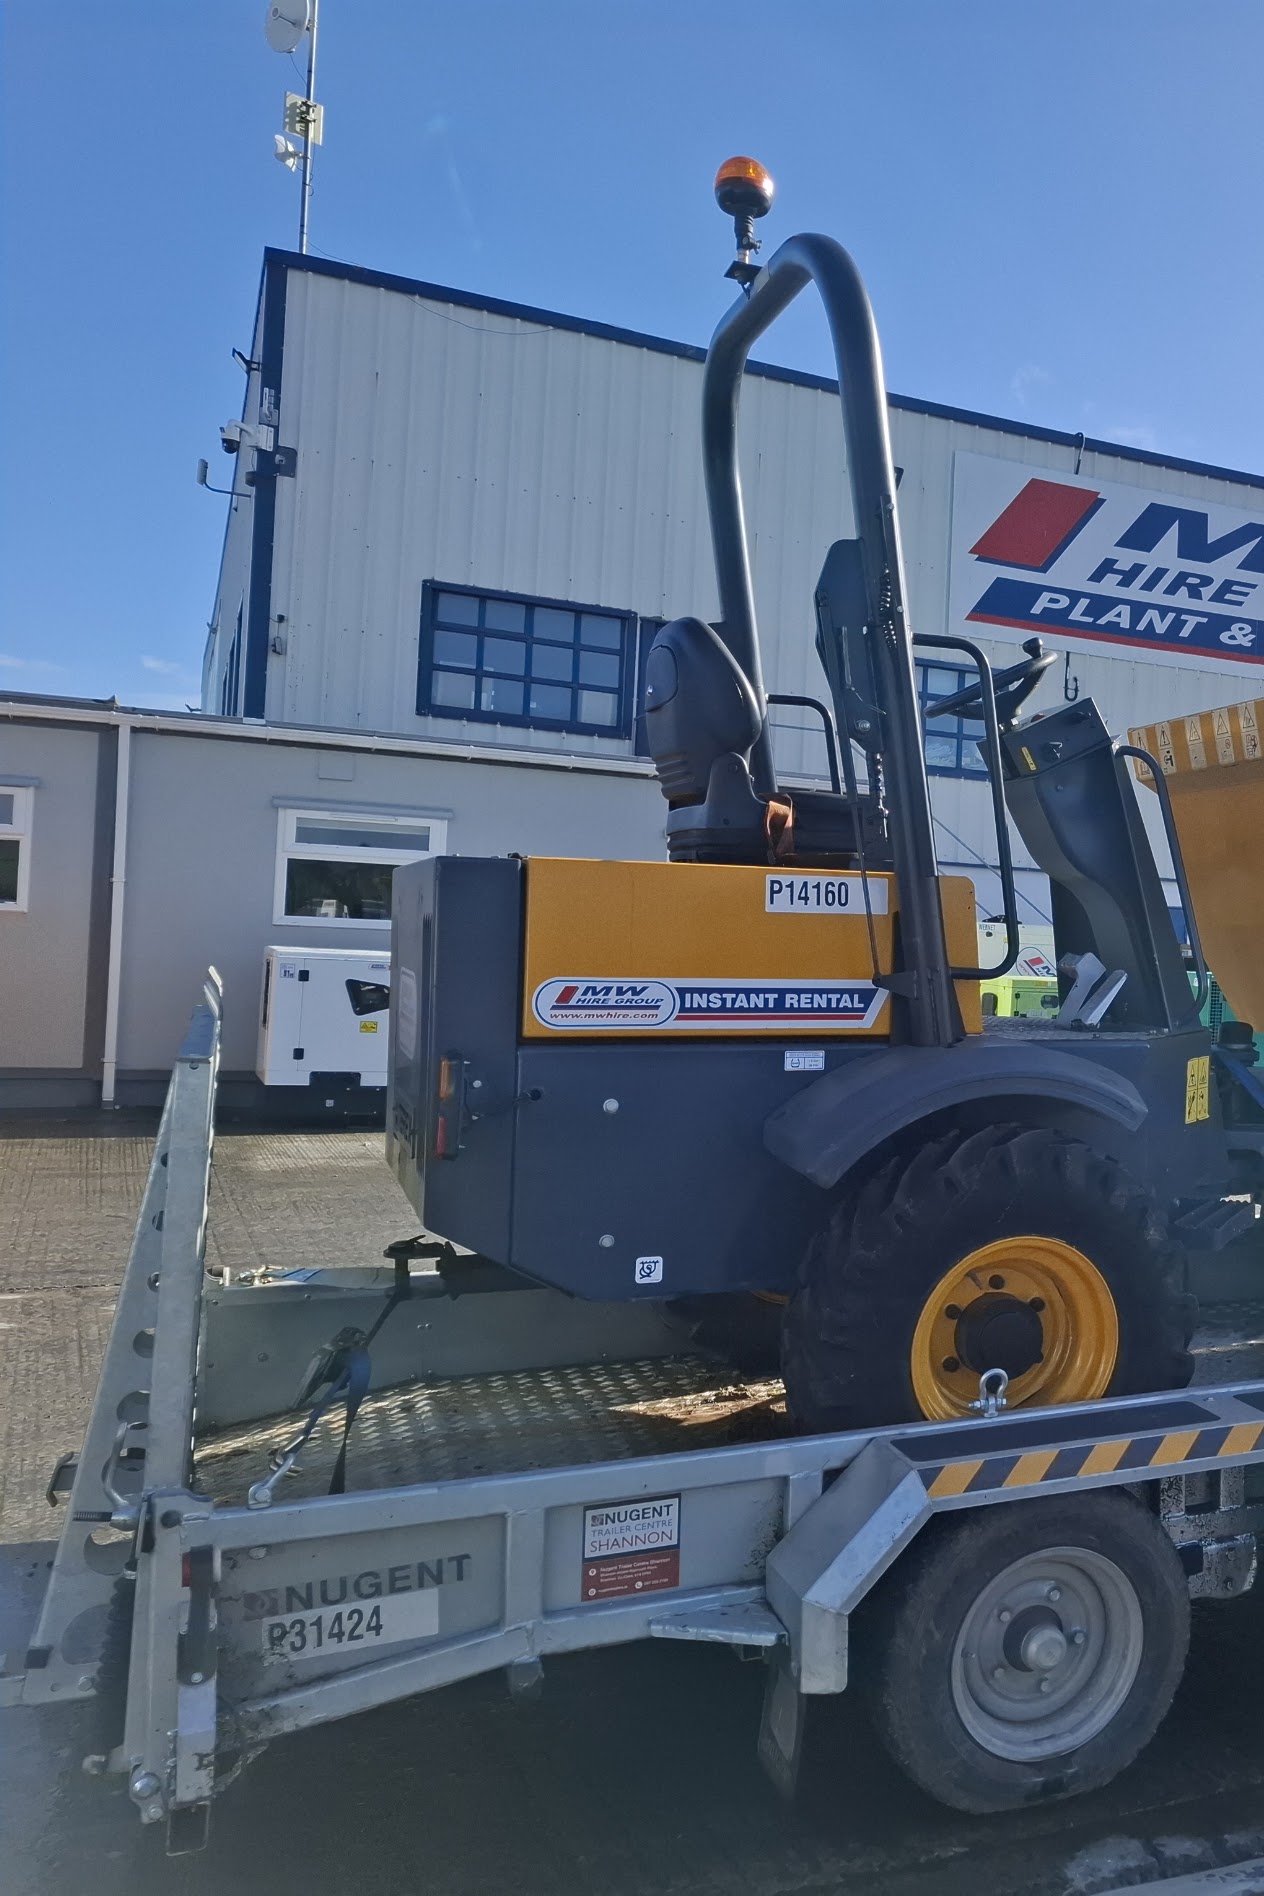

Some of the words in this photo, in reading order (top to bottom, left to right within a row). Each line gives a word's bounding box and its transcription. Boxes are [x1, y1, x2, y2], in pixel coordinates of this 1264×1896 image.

[1087, 557, 1257, 607] HIRE
[1029, 591, 1208, 640] PLANT
[1219, 622, 1254, 647] &
[769, 879, 850, 907] P14160
[580, 986, 650, 997] MW
[684, 993, 778, 1009] INSTANT
[785, 993, 865, 1009] RENTAL
[550, 1012, 659, 1020] www.mwhire.com
[605, 1504, 673, 1525] NUGENT
[591, 1525, 631, 1537] TRAILER
[634, 1519, 672, 1531] CENTRE
[590, 1529, 673, 1552] SHANNON
[285, 1554, 472, 1612] NUGENT
[267, 1605, 383, 1651] P31424
